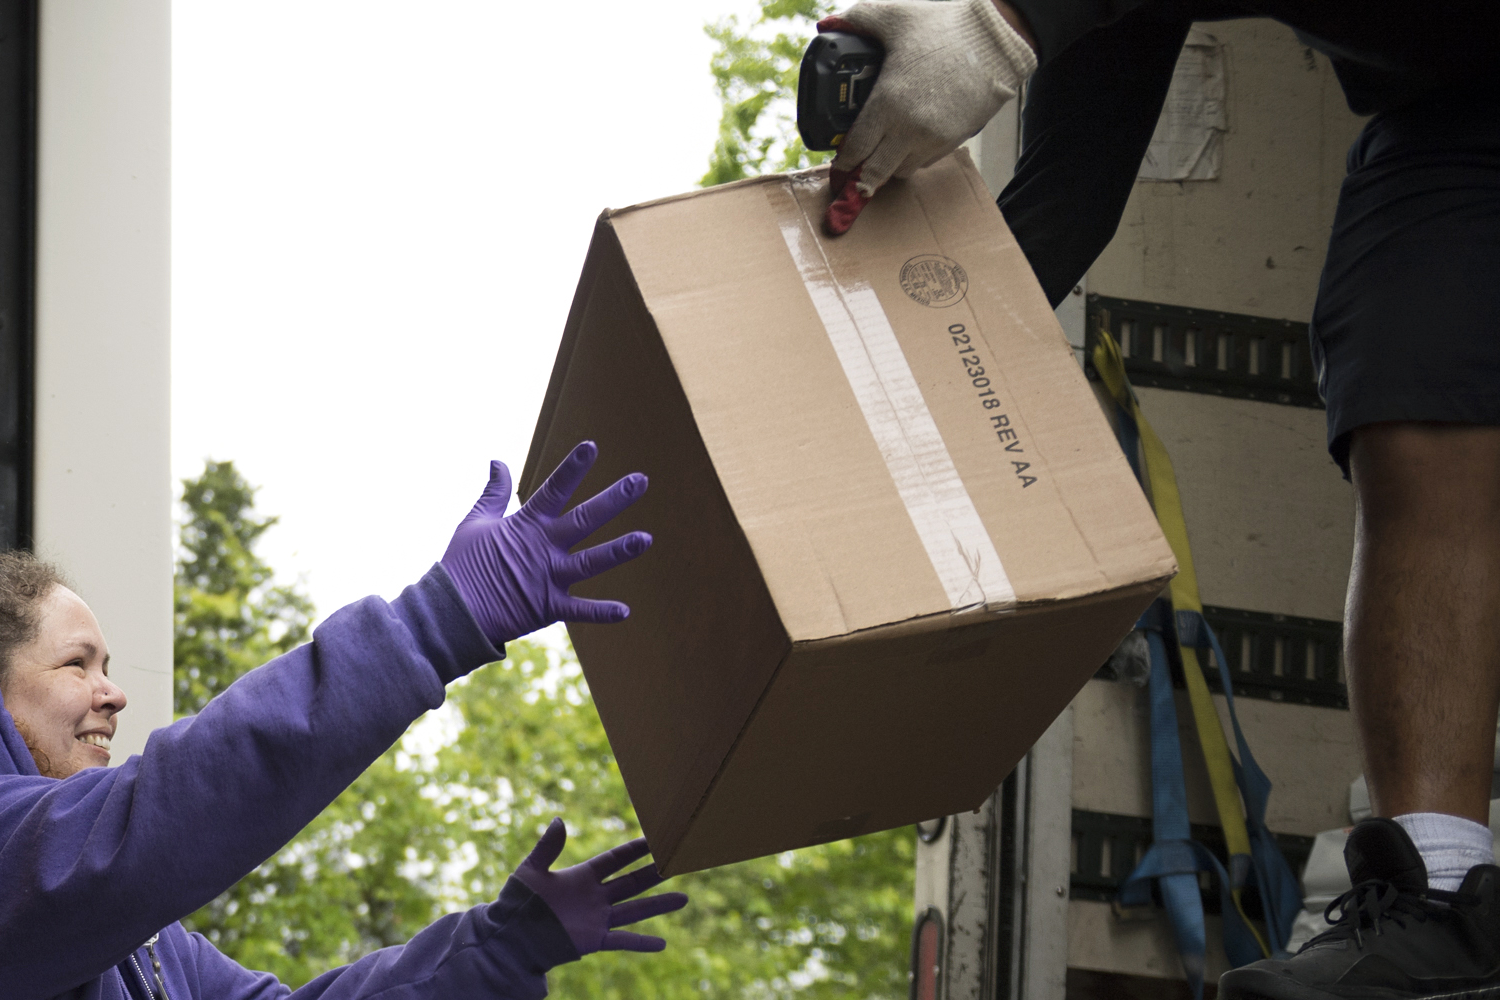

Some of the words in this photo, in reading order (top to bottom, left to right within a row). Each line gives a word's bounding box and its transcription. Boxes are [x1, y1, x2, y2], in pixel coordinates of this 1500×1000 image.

[948, 323, 1000, 409] 02123018
[990, 414, 1024, 453] REV
[1011, 461, 1038, 488] AA
